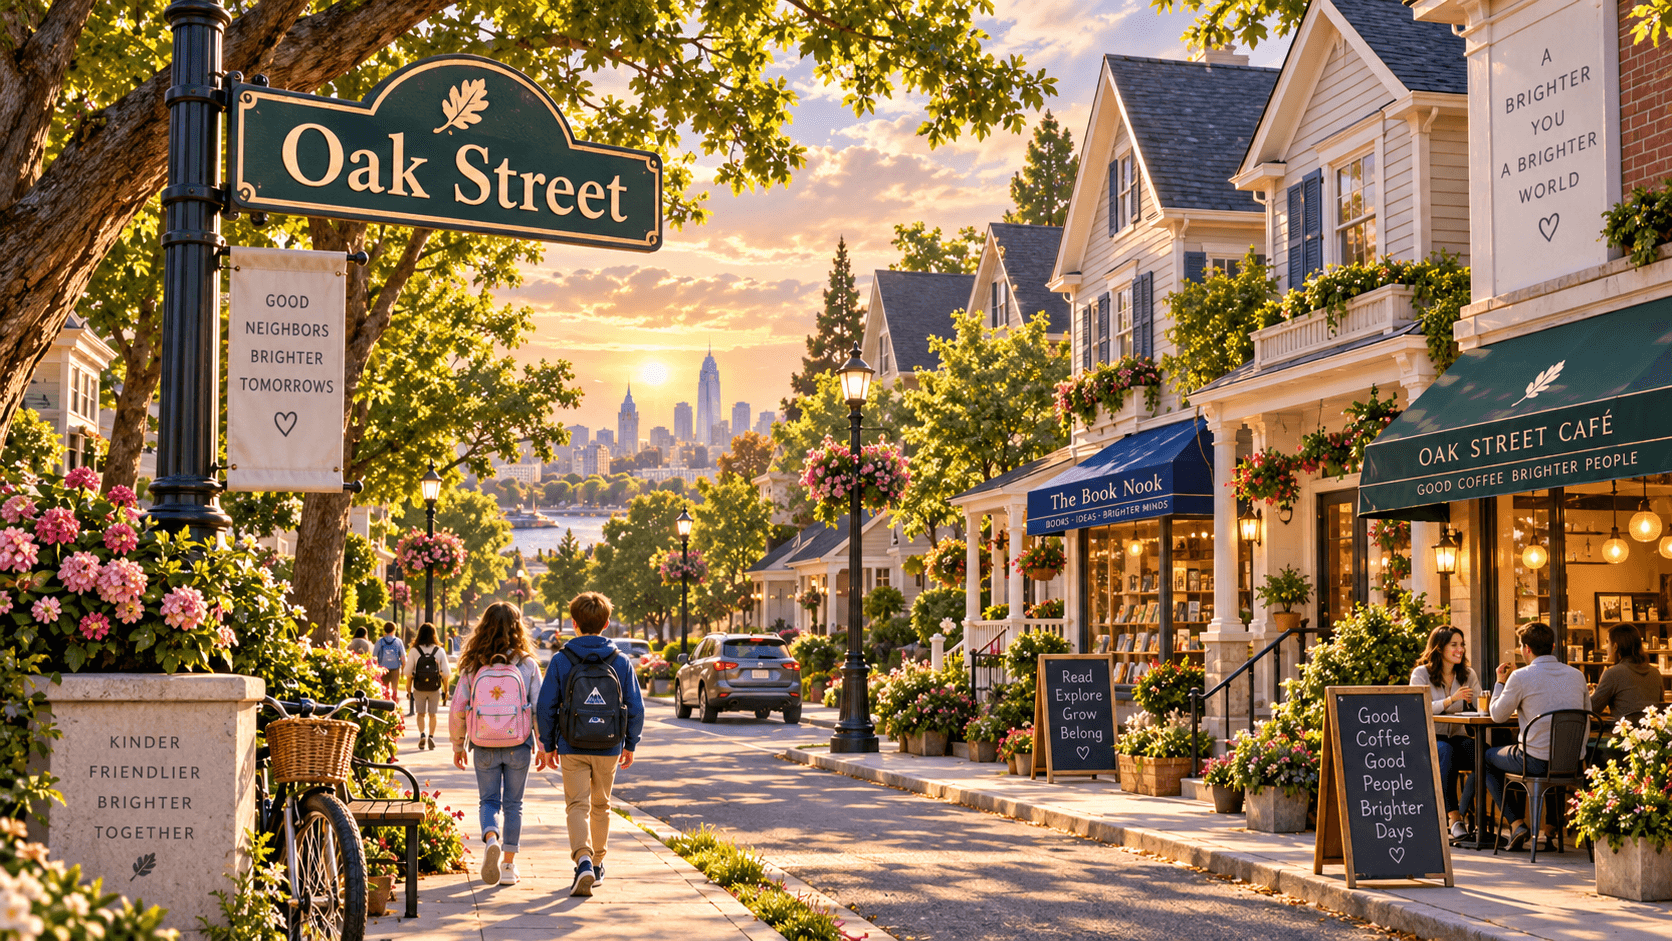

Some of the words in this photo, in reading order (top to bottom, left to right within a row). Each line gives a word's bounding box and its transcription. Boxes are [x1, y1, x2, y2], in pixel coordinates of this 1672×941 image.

[1541, 48, 1552, 66] A
[1506, 65, 1590, 114] BRIGHTER
[1531, 110, 1564, 135] YOU
[1501, 163, 1511, 178] A
[1518, 131, 1597, 172] BRIGHTER
[281, 123, 430, 199] Oak
[454, 144, 628, 222] Street
[1519, 171, 1579, 203] WORLD
[266, 294, 309, 308] GOOD
[246, 322, 328, 337] NEIGHBORS
[251, 350, 322, 364] BRIGHTER
[240, 378, 333, 393] TOMORROWS
[1419, 443, 1459, 466] OAK
[1470, 426, 1547, 458] STREET
[1558, 409, 1613, 442] CAFÉ
[1417, 479, 1452, 496] GOOD
[1458, 472, 1503, 490] COFFEE
[1512, 460, 1577, 482] BRIGHTER
[1585, 451, 1638, 471] PEOPLE
[1050, 492, 1076, 510] The
[1082, 483, 1117, 505] Book
[1124, 473, 1162, 497] Nook
[1076, 513, 1096, 523] IDEAS
[1103, 505, 1140, 518] BRIGHTER
[1063, 669, 1092, 682] Read
[1056, 688, 1102, 704] Explore
[1063, 707, 1096, 720] Grow
[1358, 706, 1399, 724] Good
[111, 736, 179, 748] KINDER
[1061, 726, 1102, 742] Belong
[1357, 729, 1410, 747] Coffee
[1365, 751, 1405, 769] Good
[90, 766, 199, 779] FRIENDLIER
[1363, 774, 1413, 796] People
[98, 796, 191, 809] BRIGHTER
[1361, 799, 1423, 821] Brighter
[94, 826, 193, 839] TOGETHER
[1376, 823, 1413, 843] Days
